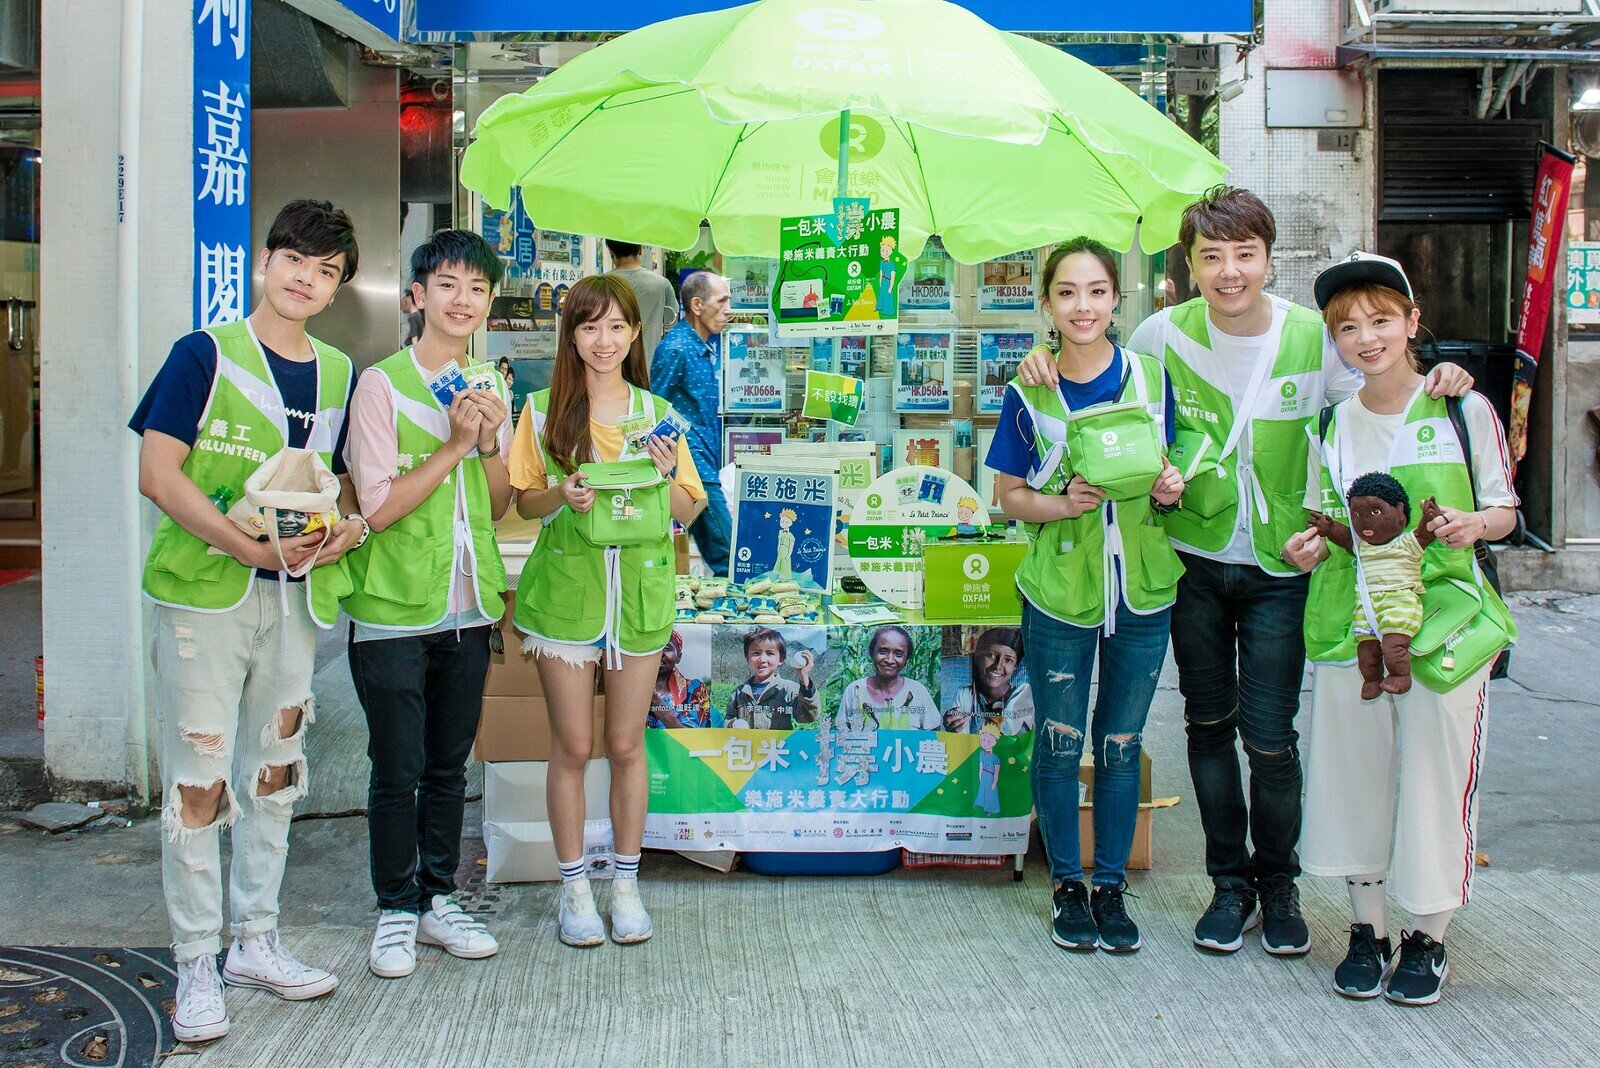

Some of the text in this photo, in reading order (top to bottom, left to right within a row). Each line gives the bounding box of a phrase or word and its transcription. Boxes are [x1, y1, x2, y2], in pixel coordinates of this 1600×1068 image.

[1337, 135, 1349, 147] 12
[208, 418, 252, 442] 義工
[840, 463, 864, 487] 米
[746, 474, 827, 502] 樂施米
[962, 594, 990, 603] OXFAM
[689, 713, 949, 787] 一包米、撐小農
[744, 789, 910, 809] 樂施米義賣大行動
